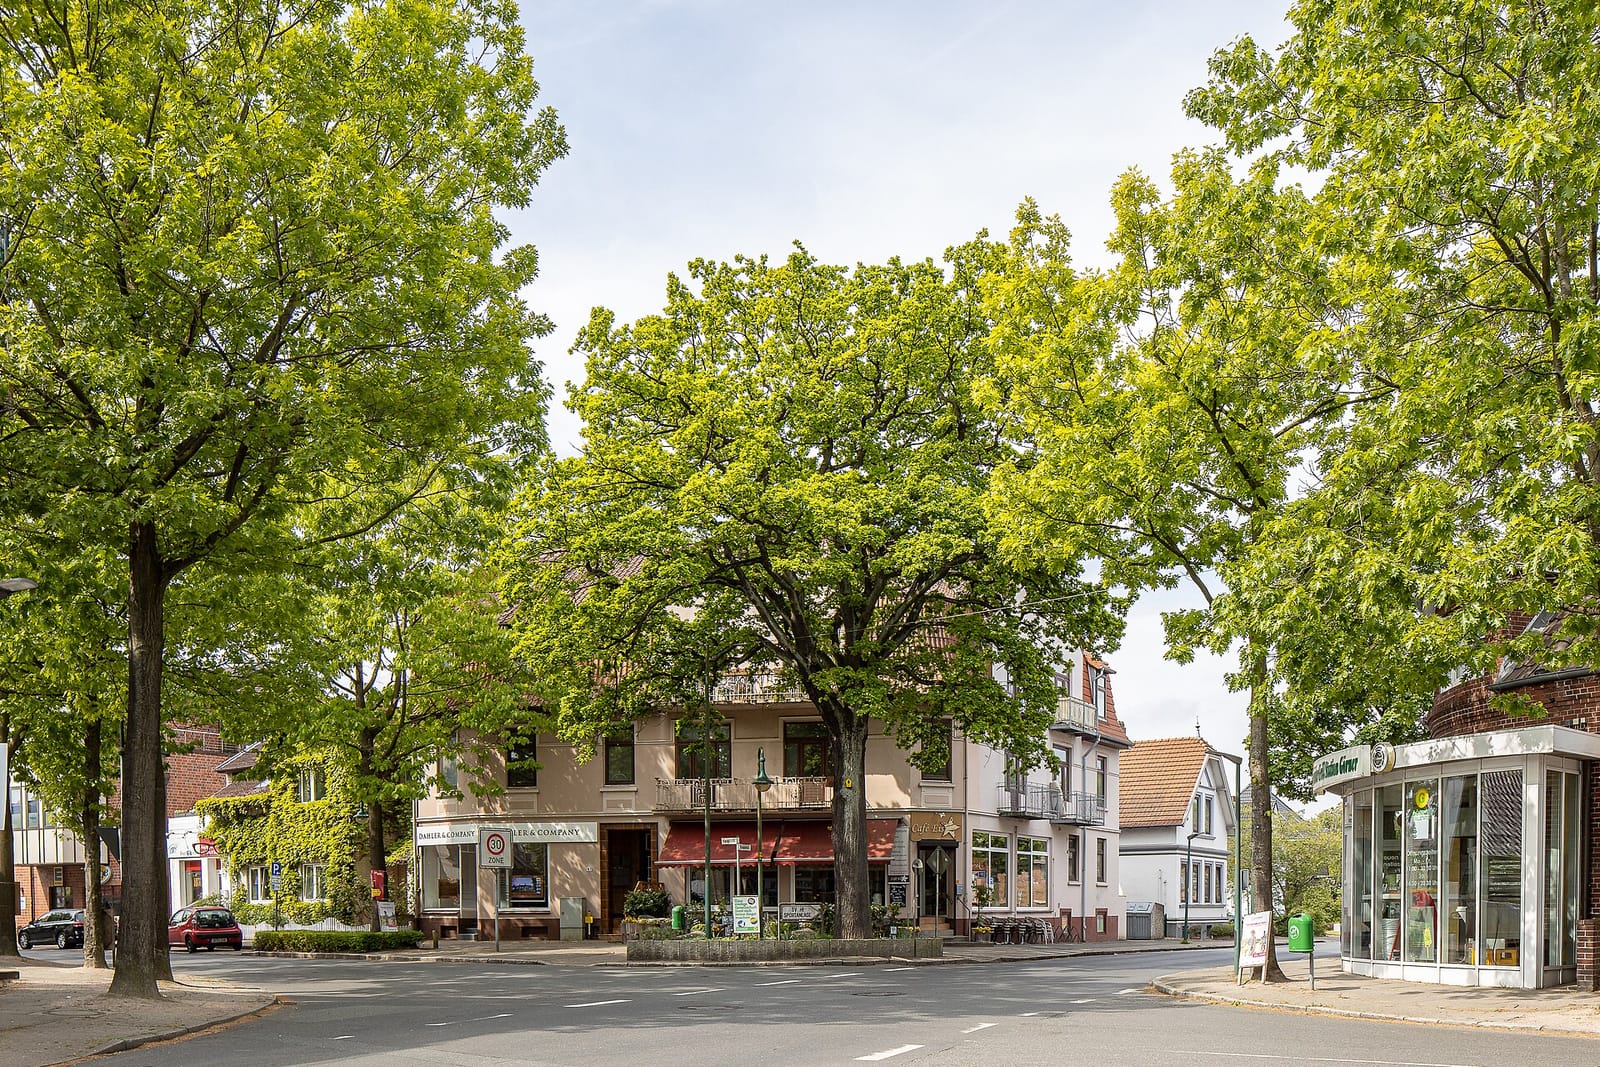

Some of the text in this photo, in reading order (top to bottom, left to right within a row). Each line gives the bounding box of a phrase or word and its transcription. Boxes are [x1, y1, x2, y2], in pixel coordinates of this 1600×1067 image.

[537, 828, 580, 837] COMPANY
[911, 822, 930, 835] Café
[418, 832, 440, 840] DAHLER
[446, 830, 475, 838] COMPANY
[490, 839, 502, 850] 30
[488, 856, 505, 864] ZONE
